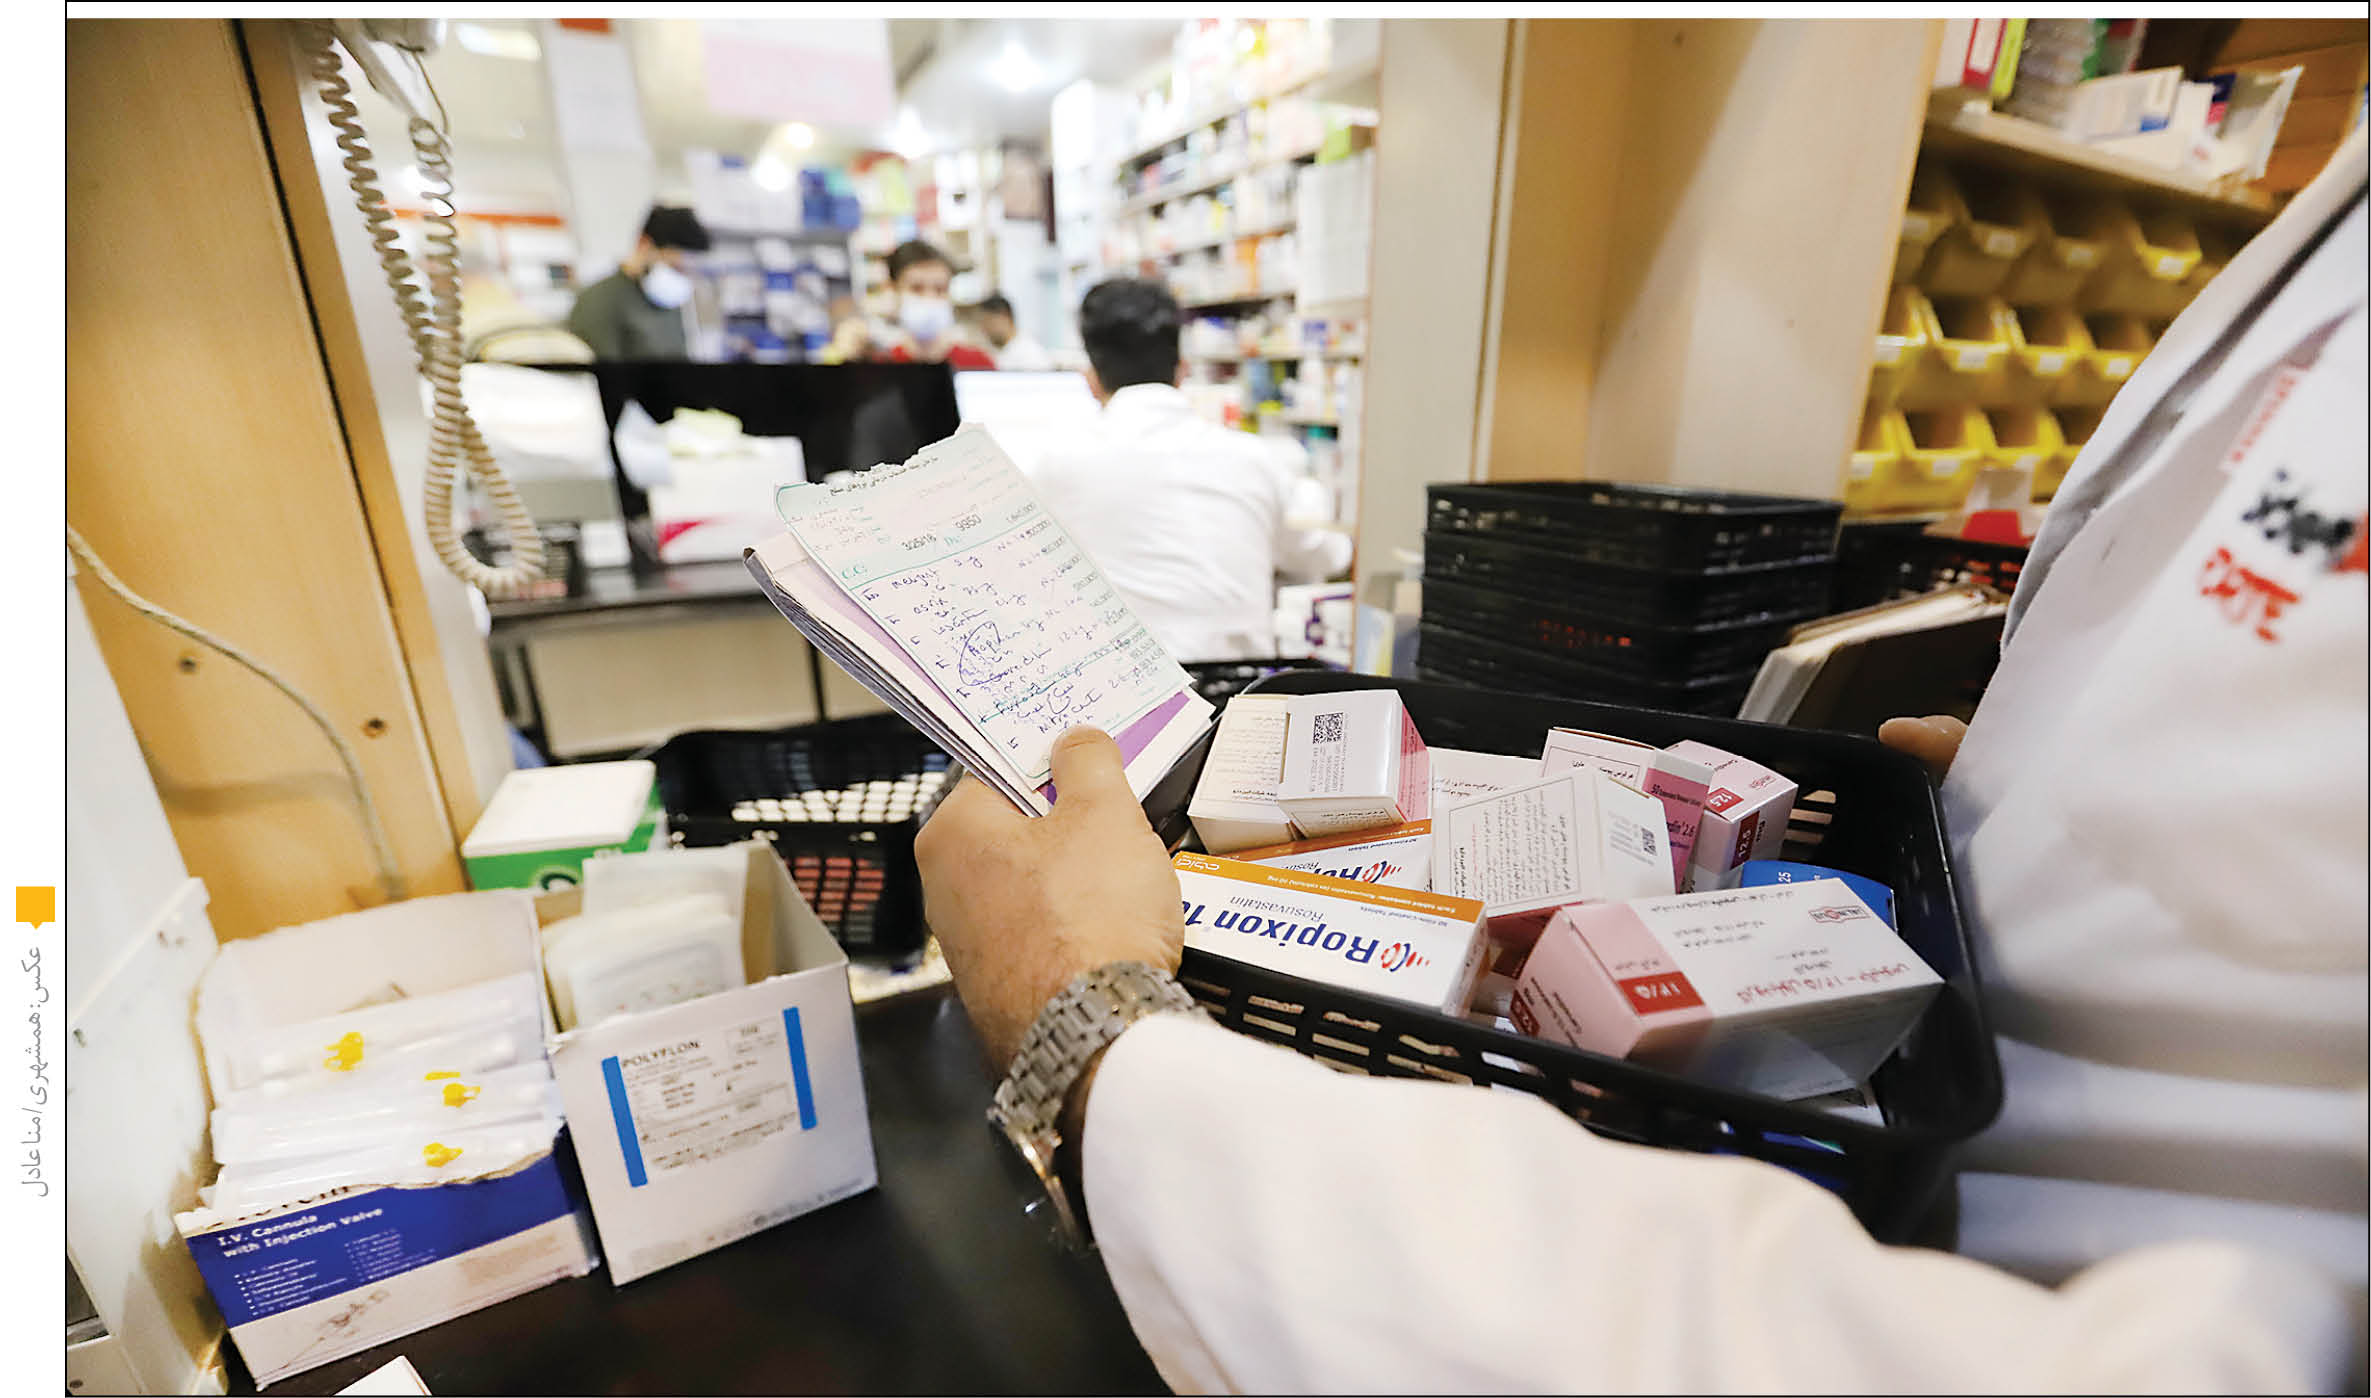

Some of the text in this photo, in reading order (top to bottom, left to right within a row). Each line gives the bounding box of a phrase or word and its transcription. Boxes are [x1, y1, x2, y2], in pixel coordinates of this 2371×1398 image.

[1230, 896, 1324, 923] Rosuvastatin
[1215, 909, 1378, 964] Ropixon
[621, 1040, 701, 1069] POLYFLON
[217, 1212, 319, 1247] I.V. Cannula
[223, 1207, 384, 1258] with Injection Valve
